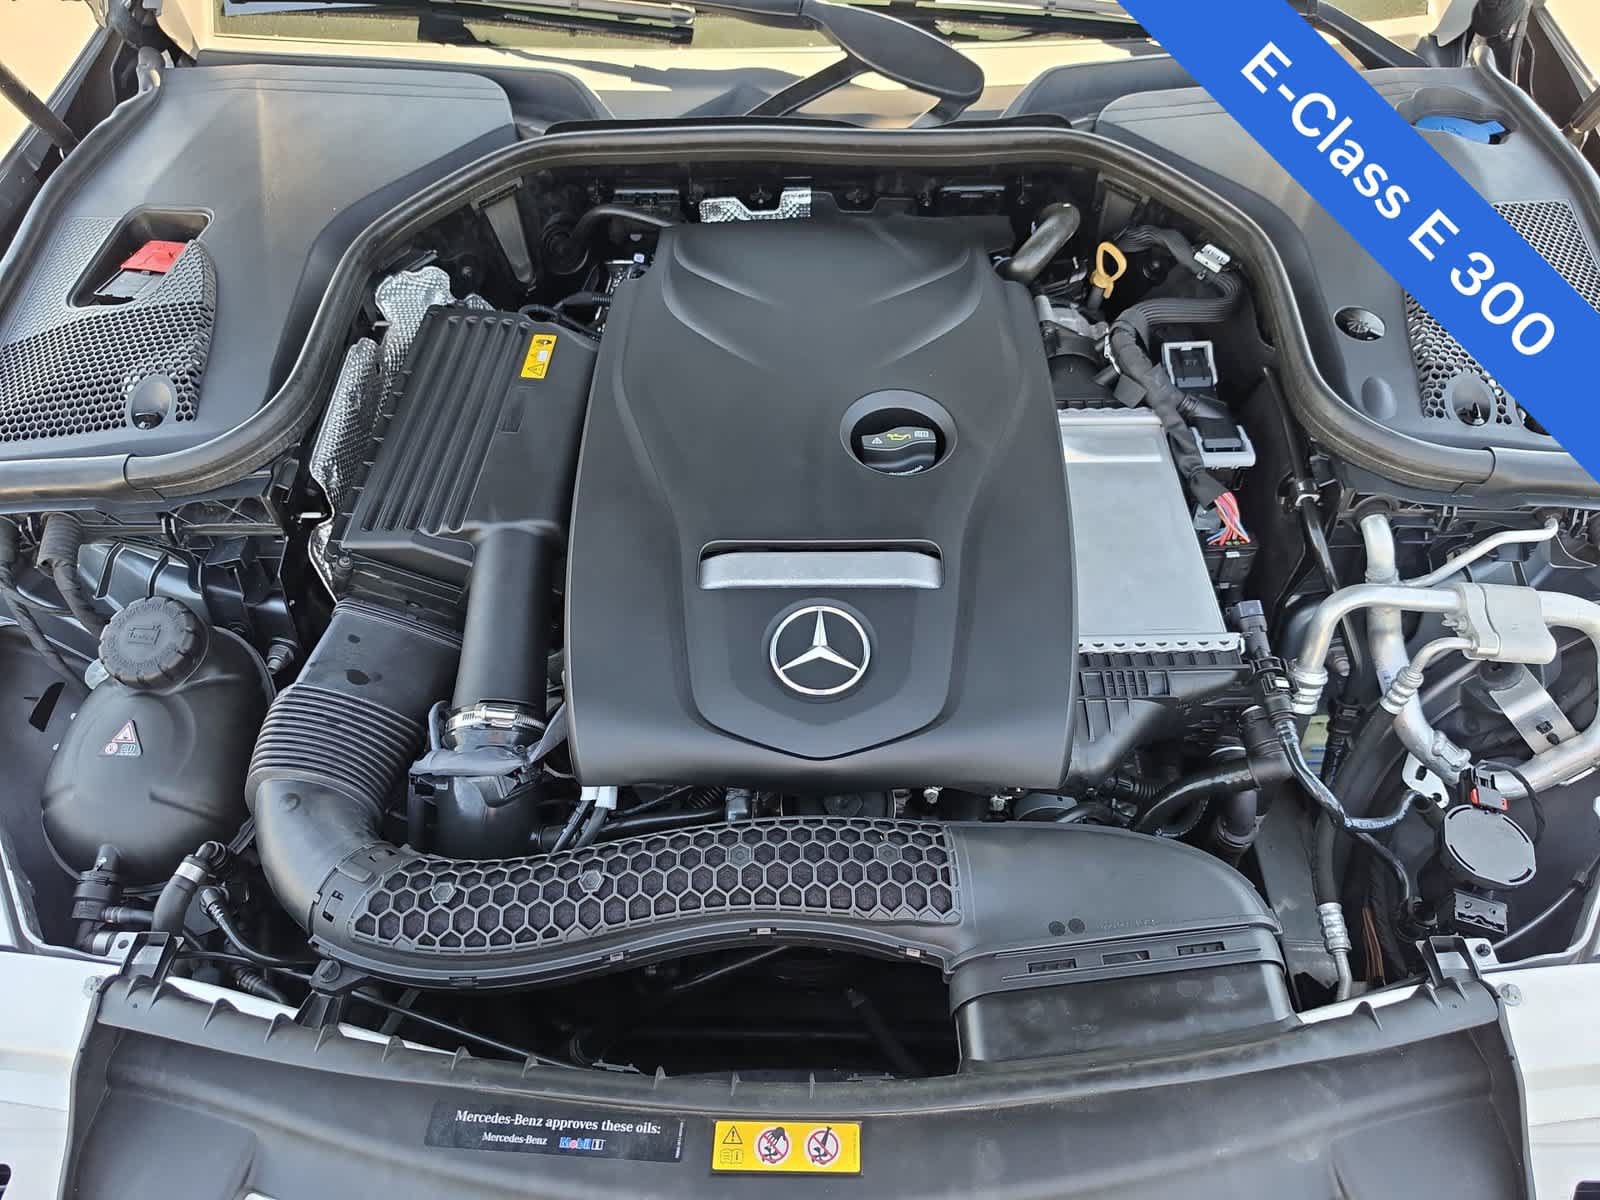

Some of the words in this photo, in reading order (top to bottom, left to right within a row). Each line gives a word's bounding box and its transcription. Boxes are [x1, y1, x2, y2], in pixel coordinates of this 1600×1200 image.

[455, 1109, 544, 1128] Mercedes-Benz
[545, 1118, 599, 1131] approves
[601, 1120, 634, 1132] these
[635, 1122, 662, 1135] oils:
[481, 1131, 548, 1146] Mercedes-Benz
